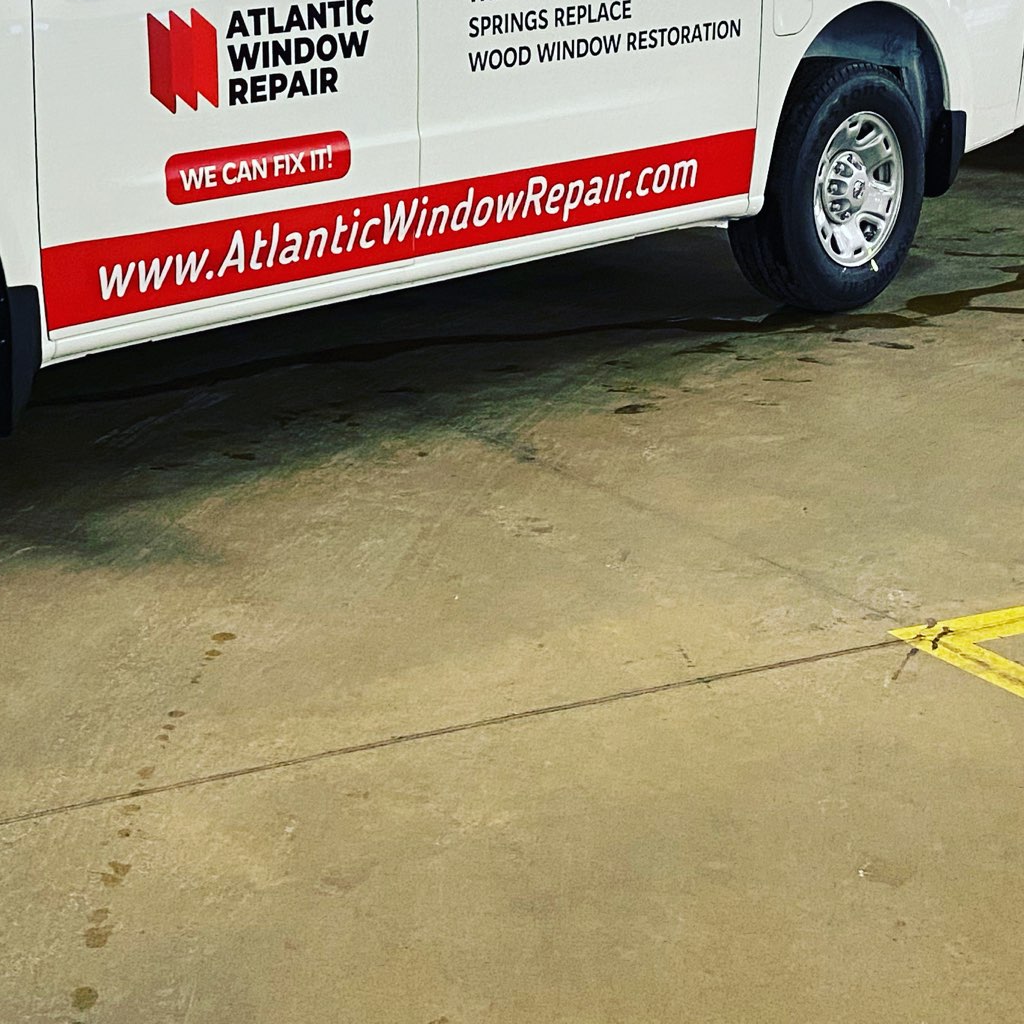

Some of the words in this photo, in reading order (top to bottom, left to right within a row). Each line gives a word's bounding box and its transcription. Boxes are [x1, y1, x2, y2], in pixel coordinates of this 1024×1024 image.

[468, 8, 549, 39] SPRINGS
[554, 0, 633, 28] REPLACE
[227, 29, 369, 72] WINDOW
[468, 44, 532, 73] WOOD
[537, 33, 622, 63] WINDOW
[626, 18, 742, 52] RESTORATION
[228, 66, 339, 107] REPAIR
[179, 165, 218, 192] WE
[221, 156, 268, 185] CAN
[273, 152, 305, 177] FIX
[309, 144, 334, 172] IT!
[98, 157, 699, 302] www.AtlanticWindowRepair.com
